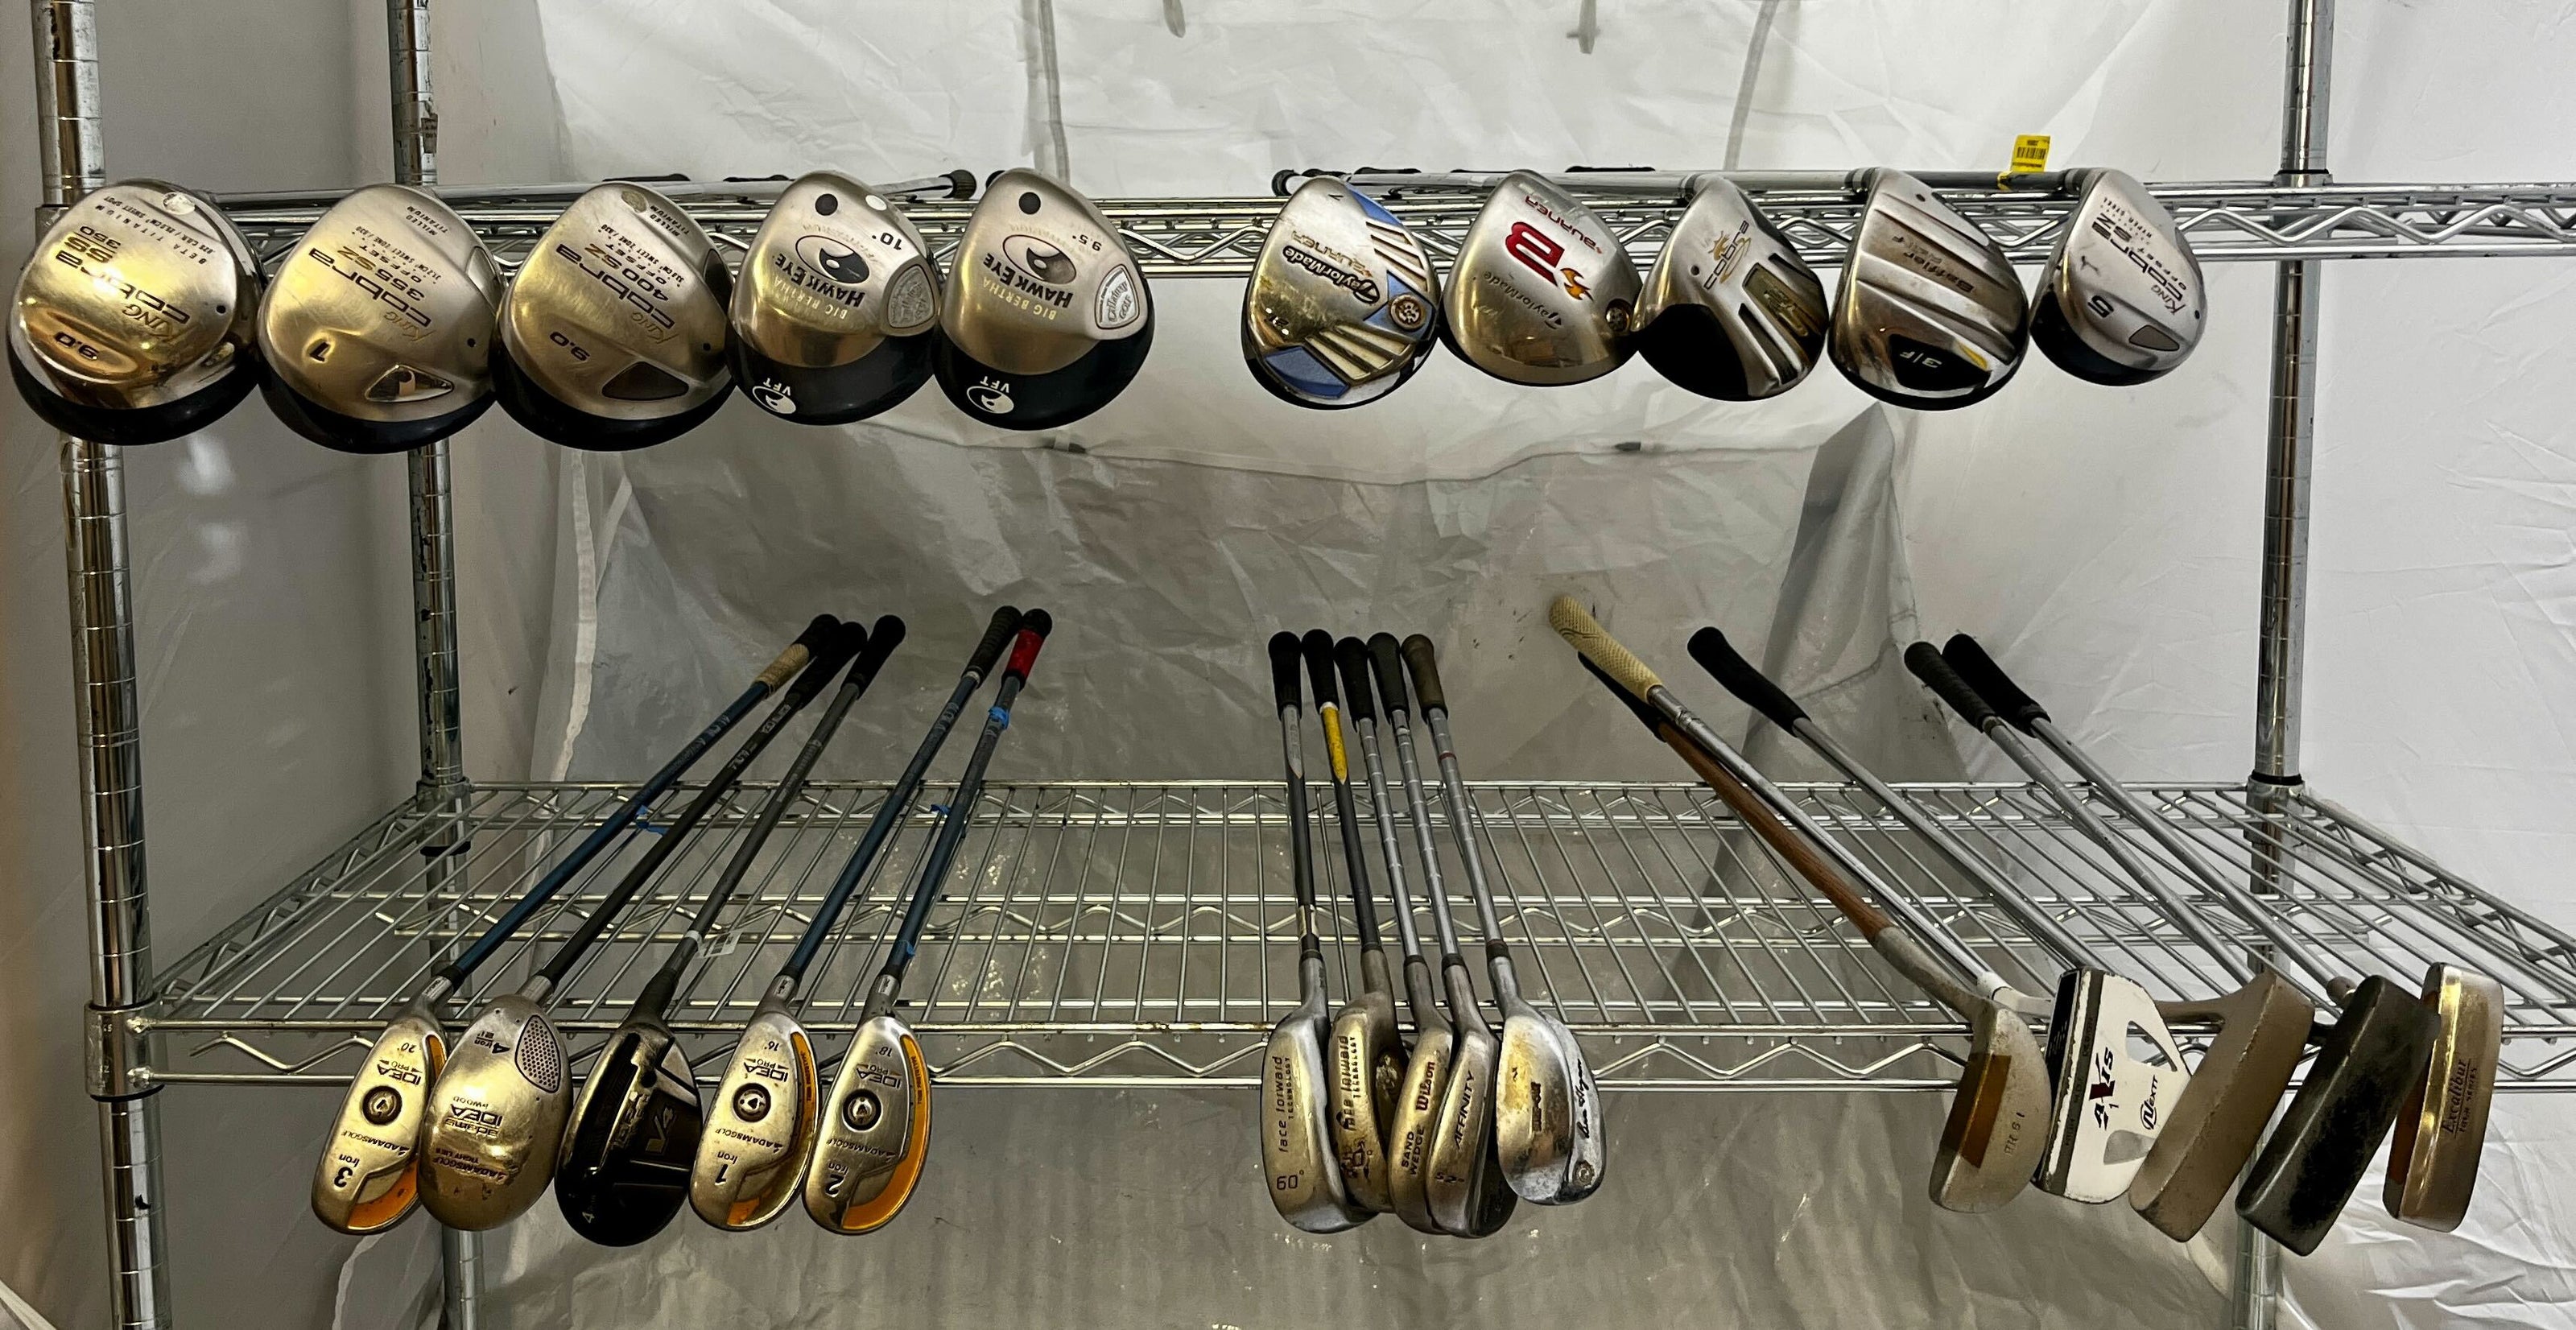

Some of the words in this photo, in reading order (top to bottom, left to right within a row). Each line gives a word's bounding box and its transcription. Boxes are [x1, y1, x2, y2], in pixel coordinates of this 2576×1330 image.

[94, 204, 164, 242] TITANIUM
[405, 214, 439, 237] MILLED
[406, 205, 449, 234] TITANIUM
[650, 204, 690, 235] TITANIUM
[650, 213, 681, 238] MILLED
[1524, 195, 1598, 251] BURNER
[2096, 212, 2132, 242] SZ
[2128, 217, 2153, 239] HYPER
[64, 235, 115, 265] SS
[79, 225, 122, 251] 350
[1290, 229, 1367, 277] BURNER
[358, 244, 423, 283] OFFSET
[391, 247, 416, 265] SWEET
[605, 243, 668, 285] OFFSET
[635, 246, 659, 265] SWEET
[1703, 219, 1750, 291] cobra
[2091, 221, 2184, 303] cobra
[2136, 246, 2188, 291] OFFSET
[308, 246, 432, 328] cobra
[374, 268, 425, 302] 355
[555, 243, 676, 330] cobra
[621, 268, 670, 302] 400
[1282, 245, 1381, 305] TaylorMade
[1902, 250, 1975, 294] Baffler
[982, 275, 1029, 312] BERTHA
[1483, 270, 1563, 331] TaylorMade
[2087, 294, 2115, 319] 5
[1033, 303, 1057, 320] BIG
[54, 330, 101, 361] 9.0
[309, 341, 331, 363] 1
[549, 330, 591, 362] 9.0
[763, 377, 793, 397] VFT
[980, 375, 1011, 394] VFT
[473, 1036, 493, 1051] Iron
[376, 1063, 423, 1087] IDEA
[743, 1061, 789, 1083] IDEA
[856, 1067, 902, 1090] IDEA
[1272, 1055, 1286, 1113] forward
[1415, 1060, 1435, 1112] Wilson
[1284, 1056, 1294, 1121] TECHNOLOGY
[2089, 1047, 2116, 1131] AXIS
[2441, 1059, 2467, 1134] Excalibur
[450, 1102, 504, 1127] IDEA
[1455, 1070, 1476, 1150] AFFINITY
[341, 1129, 402, 1153] ADAMSGOLF
[715, 1127, 779, 1148] ADAMSGOLF
[826, 1137, 890, 1156] ADAMSGOLF
[1278, 1119, 1289, 1154] face
[1402, 1131, 1415, 1169] SAND
[1410, 1124, 1426, 1176] WEDGE
[338, 1153, 361, 1168] Iron
[716, 1150, 739, 1165] Iron
[827, 1161, 850, 1176] Iron
[333, 1166, 354, 1188] 3
[714, 1163, 729, 1186] 1
[824, 1173, 846, 1198] 2
